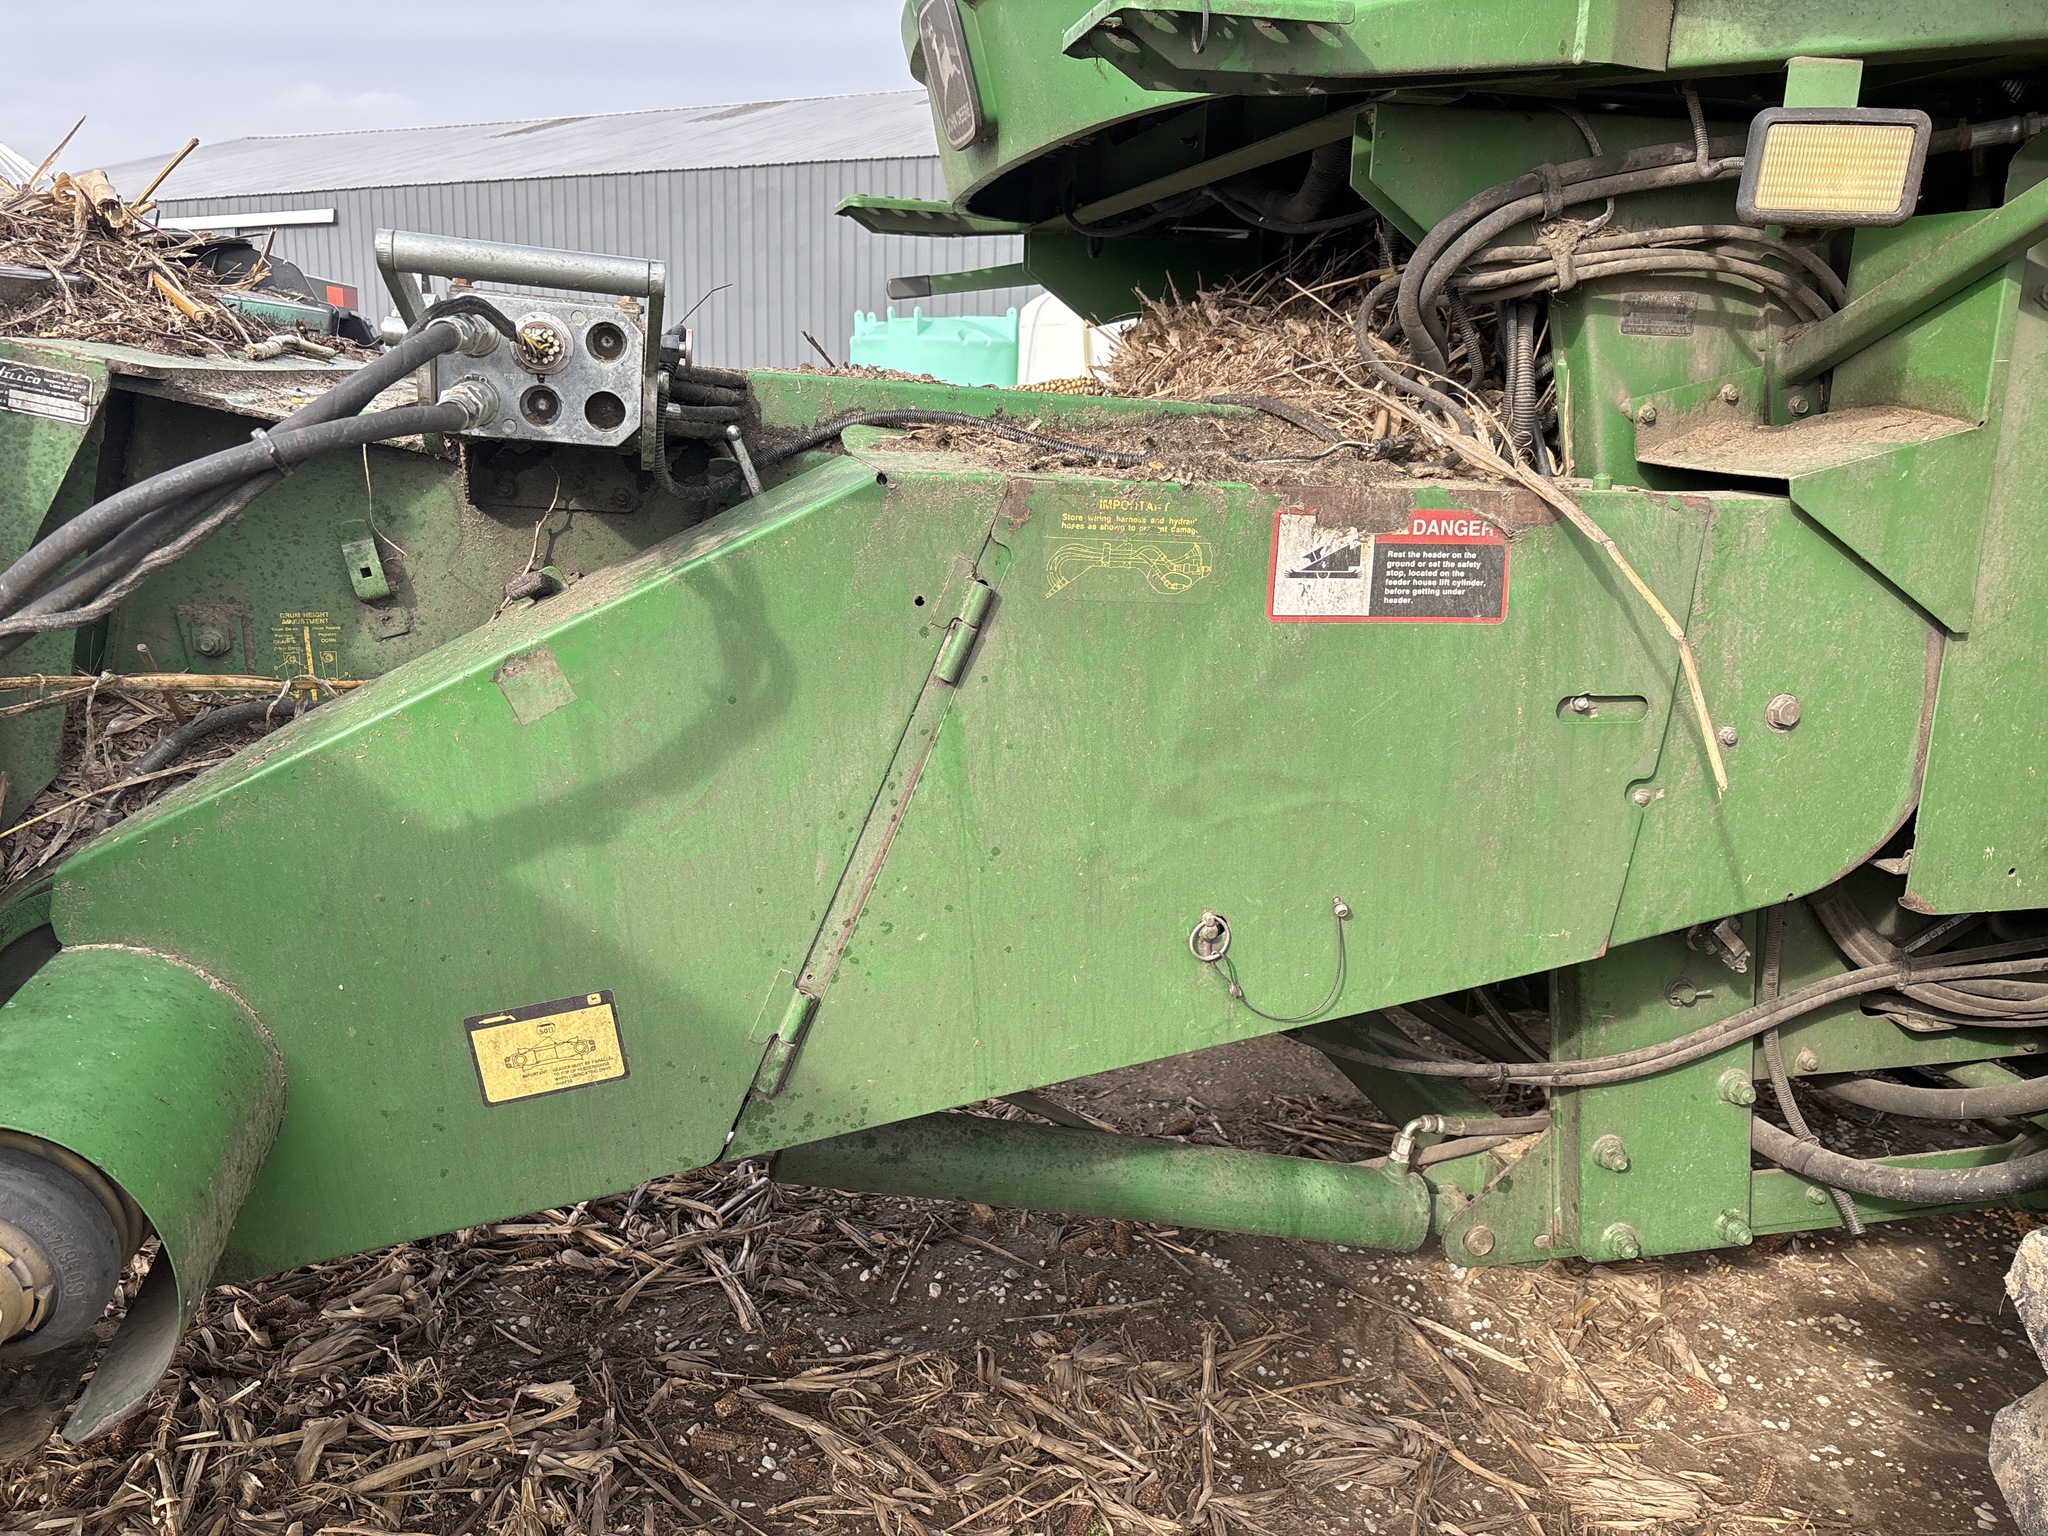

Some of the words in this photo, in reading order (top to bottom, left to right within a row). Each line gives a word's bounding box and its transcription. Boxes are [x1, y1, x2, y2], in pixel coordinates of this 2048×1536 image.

[1061, 512, 1083, 521] Store
[1087, 514, 1112, 524] wiring
[1116, 515, 1147, 524] harness
[1061, 521, 1085, 529] hoses
[1128, 524, 1136, 532] to
[1387, 550, 1406, 559] Rest
[1407, 550, 1421, 559] the
[1422, 551, 1450, 559] header
[1464, 551, 1477, 559] the
[1386, 560, 1415, 569] ground
[1457, 561, 1481, 570] safety
[1386, 569, 1406, 578] stop,
[1408, 569, 1438, 577] located
[1451, 579, 1487, 588] cylinder,
[1412, 588, 1440, 597] getting
[1442, 588, 1465, 596] under
[1383, 596, 1414, 604] header.
[522, 1069, 548, 1079] IMPORTANT
